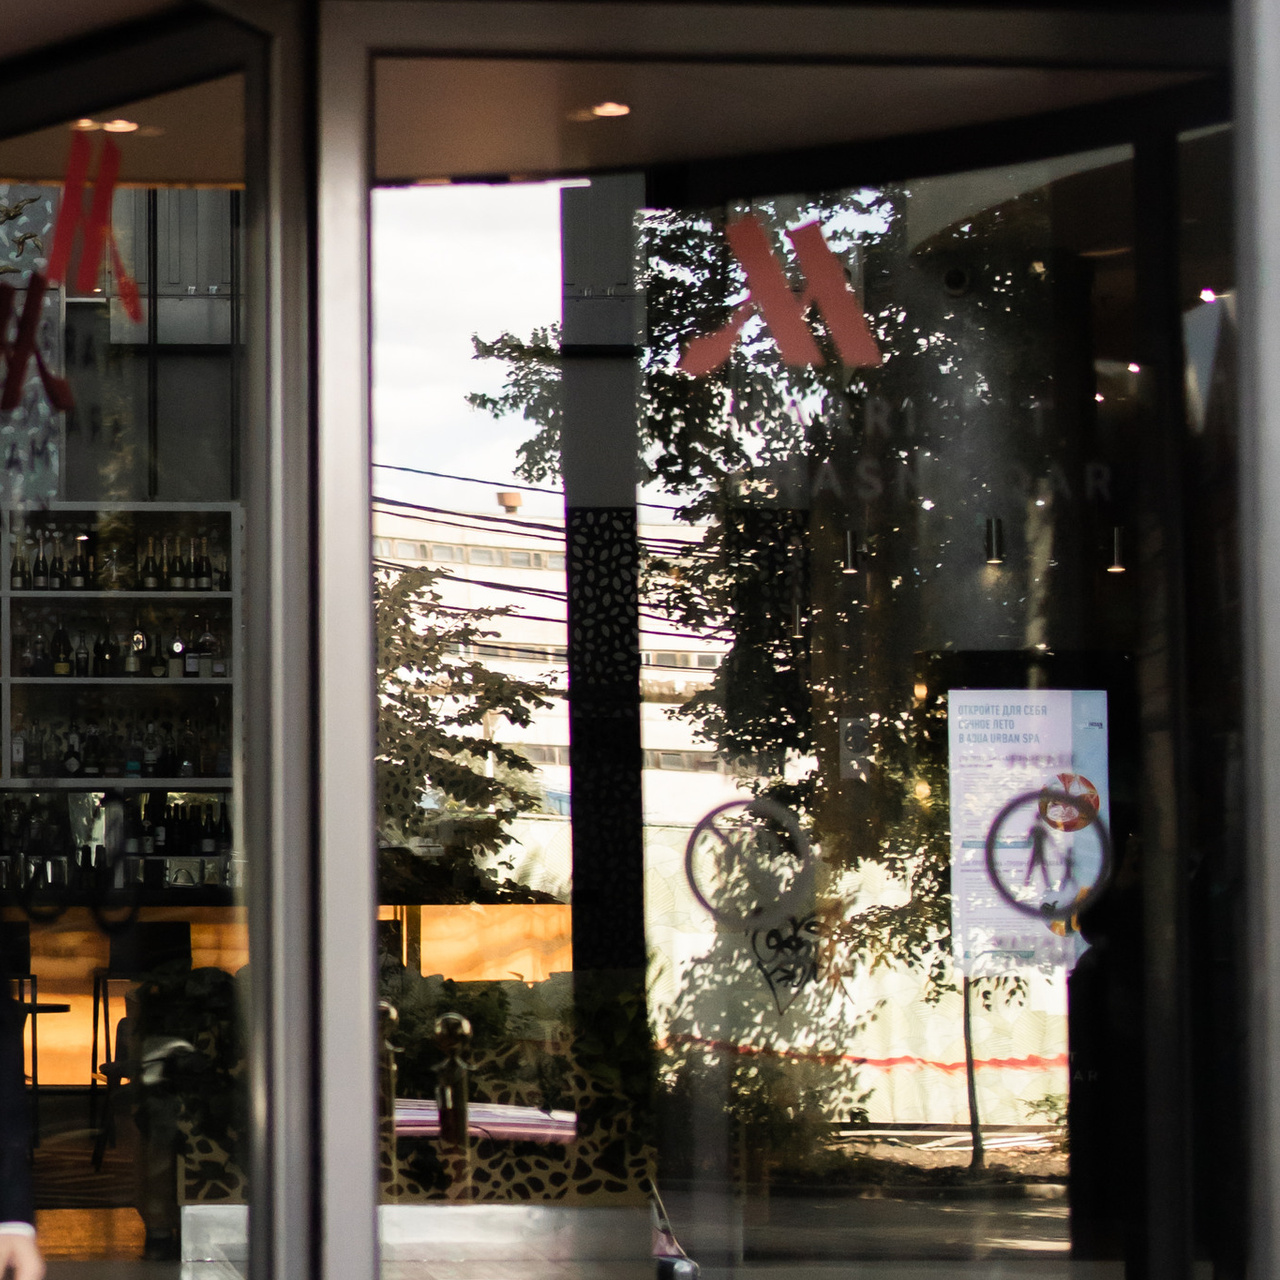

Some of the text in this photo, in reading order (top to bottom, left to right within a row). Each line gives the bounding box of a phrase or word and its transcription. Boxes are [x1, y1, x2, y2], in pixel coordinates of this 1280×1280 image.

[958, 704, 1047, 717] ОТКРОЙТЕ ДЛЯ СЕБЯ
[993, 719, 1015, 730] ЛЕТО
[990, 733, 1020, 744] URBAN
[1022, 733, 1040, 744] SPA
